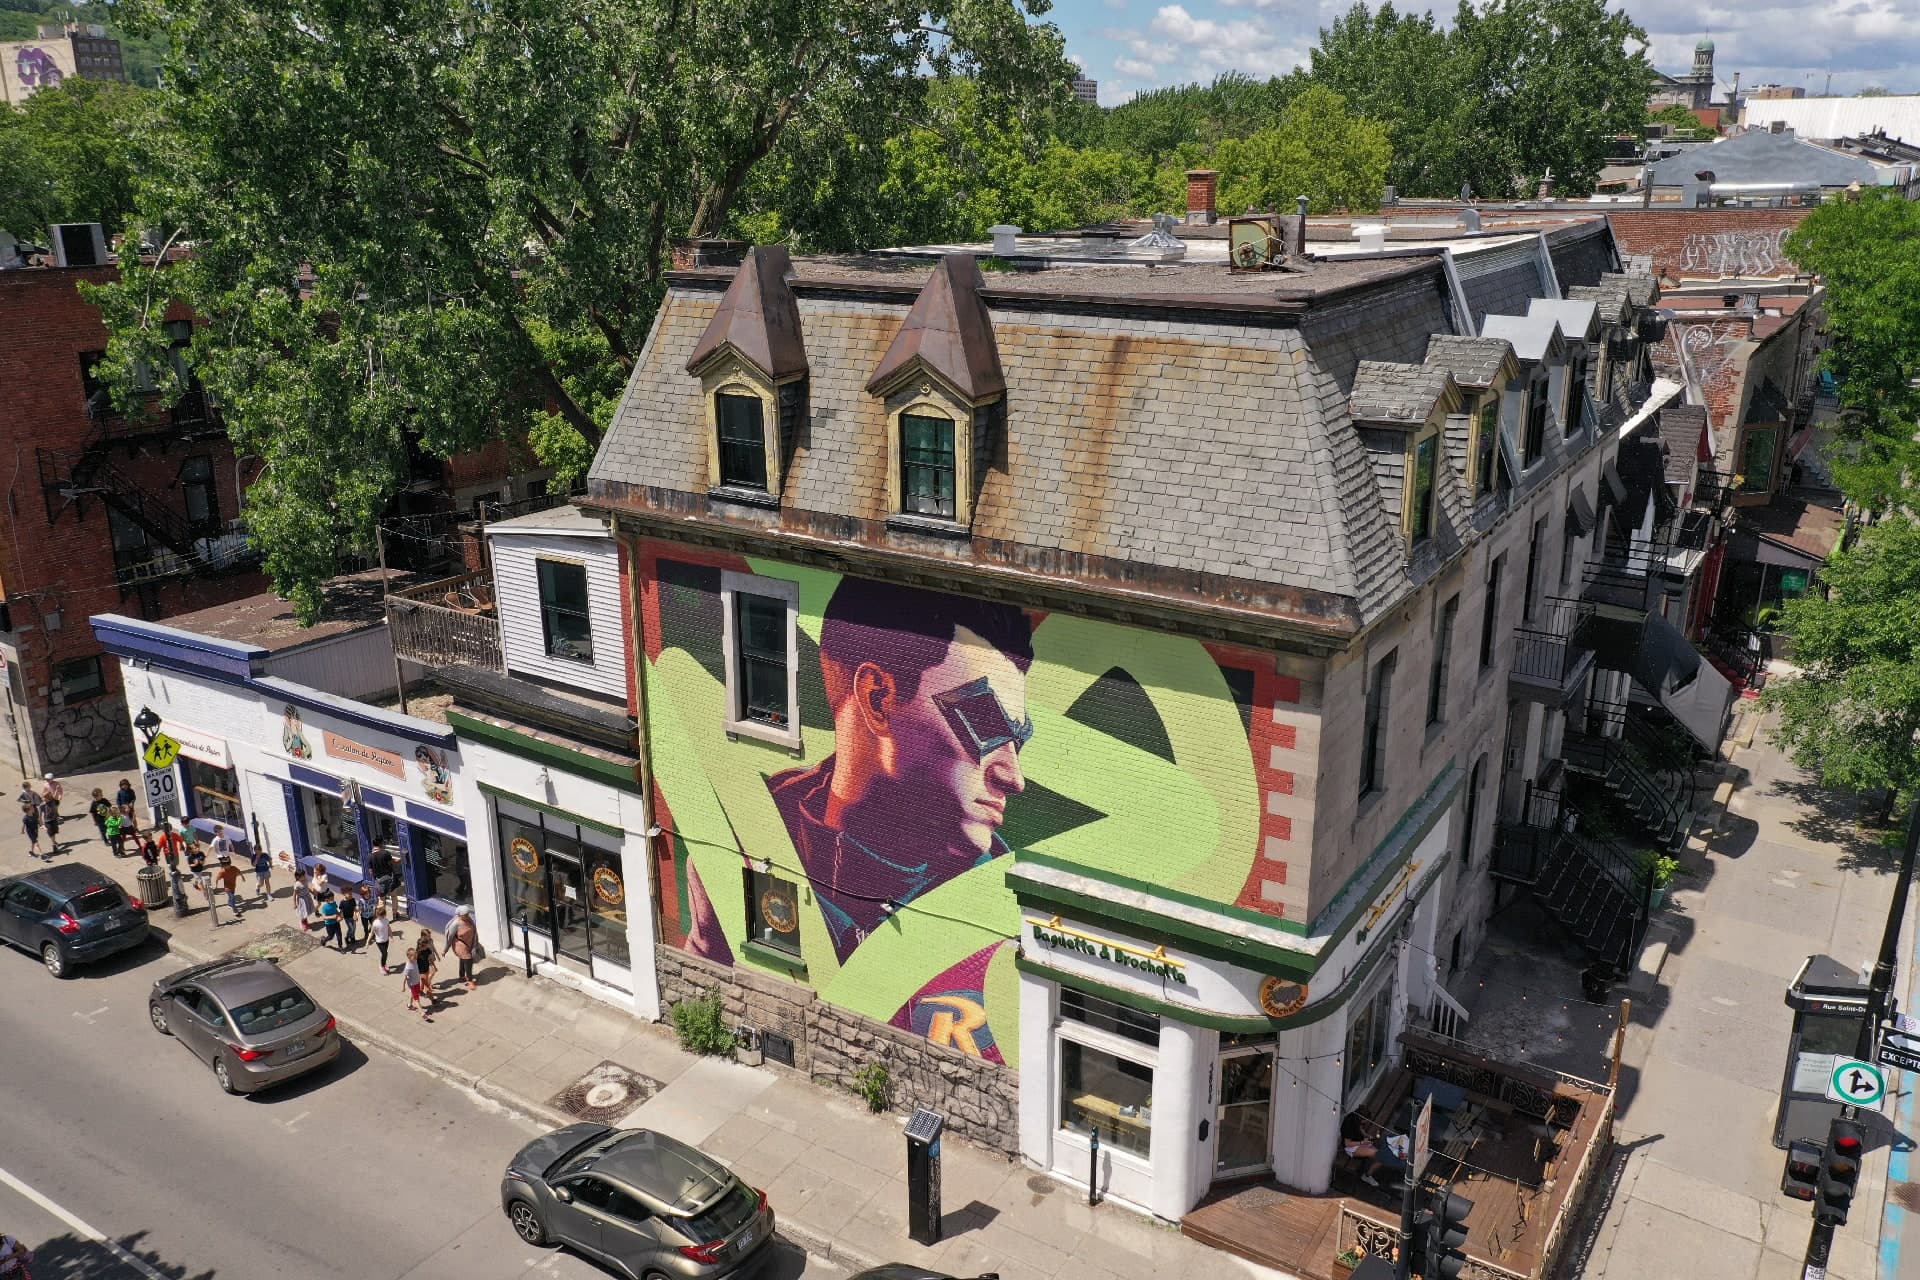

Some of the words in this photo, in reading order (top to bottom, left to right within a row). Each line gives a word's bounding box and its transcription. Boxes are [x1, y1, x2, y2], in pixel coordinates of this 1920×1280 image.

[150, 774, 174, 796] 30
[1033, 925, 1097, 956] Baguette
[1099, 944, 1111, 960] &
[1114, 948, 1187, 984] Brochette
[1264, 995, 1307, 1015] Brochette
